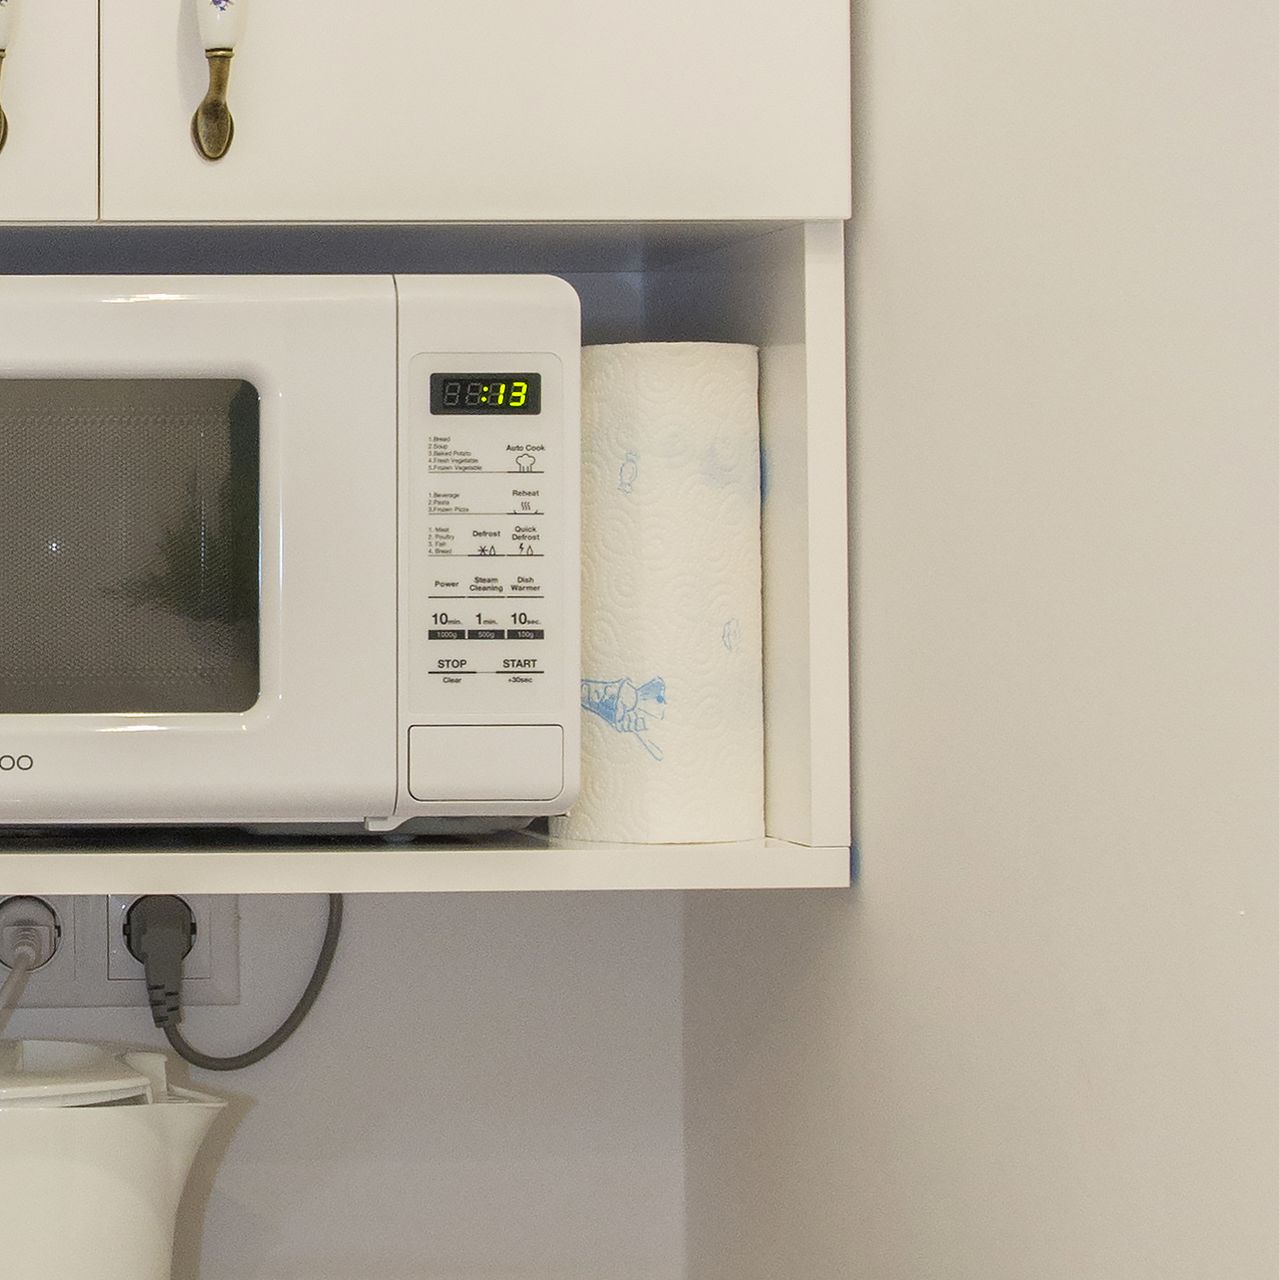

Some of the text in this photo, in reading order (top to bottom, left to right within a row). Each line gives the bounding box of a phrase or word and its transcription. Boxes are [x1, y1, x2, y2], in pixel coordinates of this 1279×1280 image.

[506, 444, 545, 452] Auto Cook
[434, 580, 459, 588] Power
[474, 576, 499, 584] Steam
[517, 576, 535, 584] Dish
[469, 584, 504, 593] Cleaning
[437, 659, 467, 669] STOP
[502, 659, 538, 669] START
